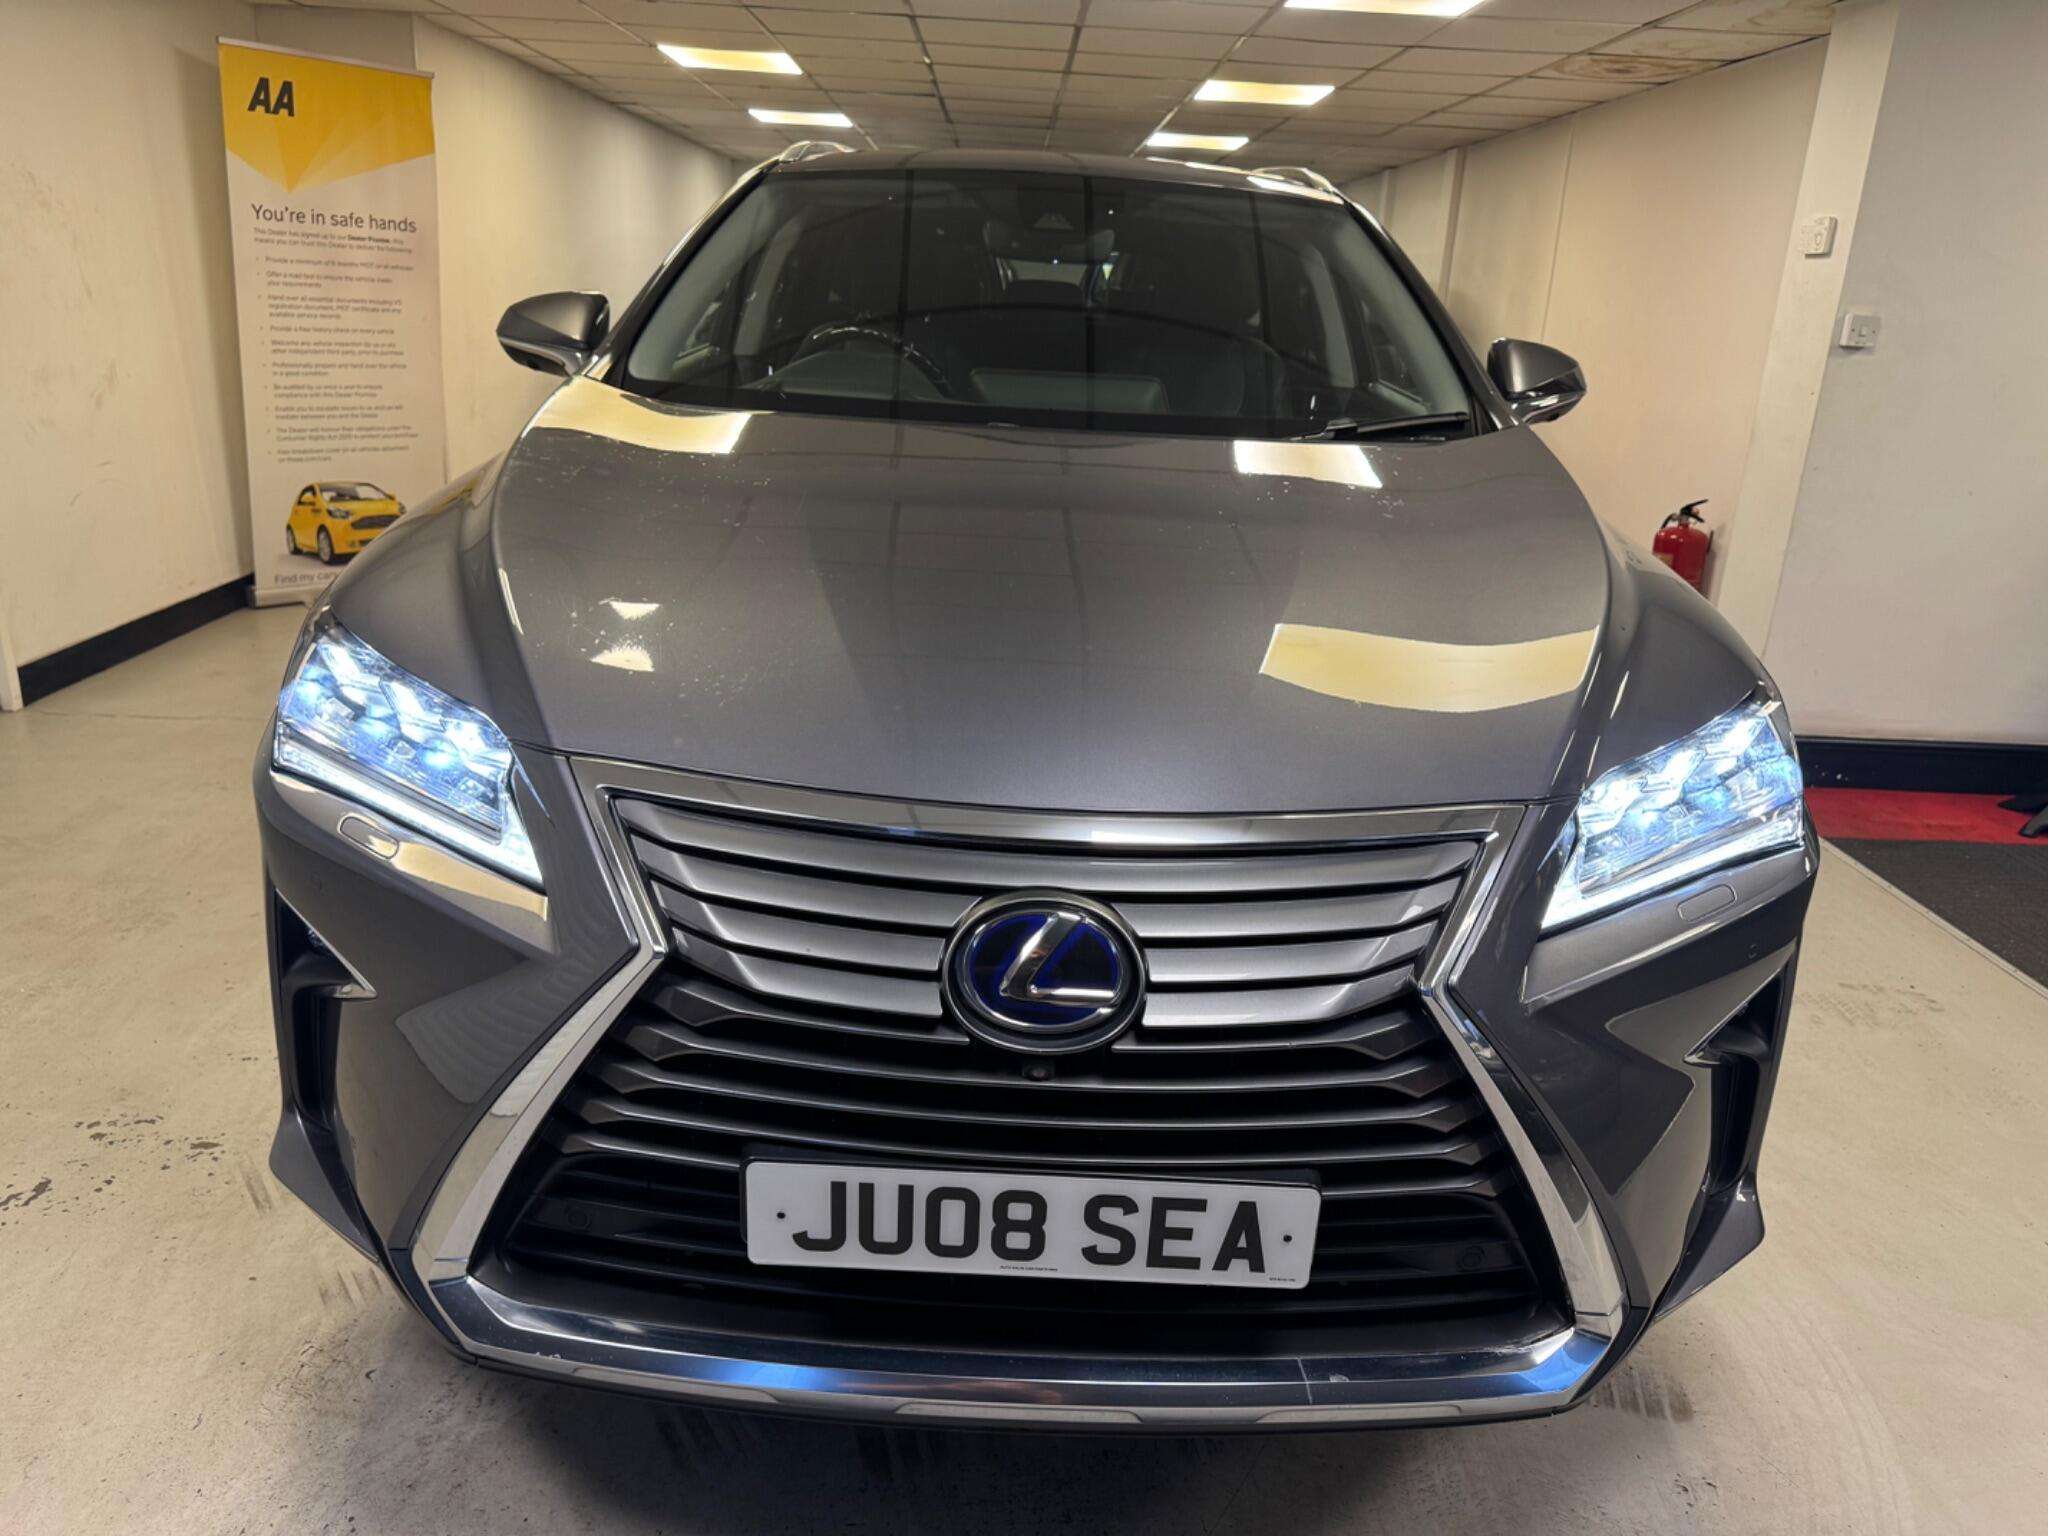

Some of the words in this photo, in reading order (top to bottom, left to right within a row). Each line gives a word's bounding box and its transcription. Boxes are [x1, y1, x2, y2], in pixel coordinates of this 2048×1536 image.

[247, 77, 295, 117] AA
[251, 203, 305, 224] You're
[310, 208, 326, 226] in
[330, 211, 364, 229] safe
[369, 214, 417, 233] hands
[1081, 1193, 1266, 1274] SEA
